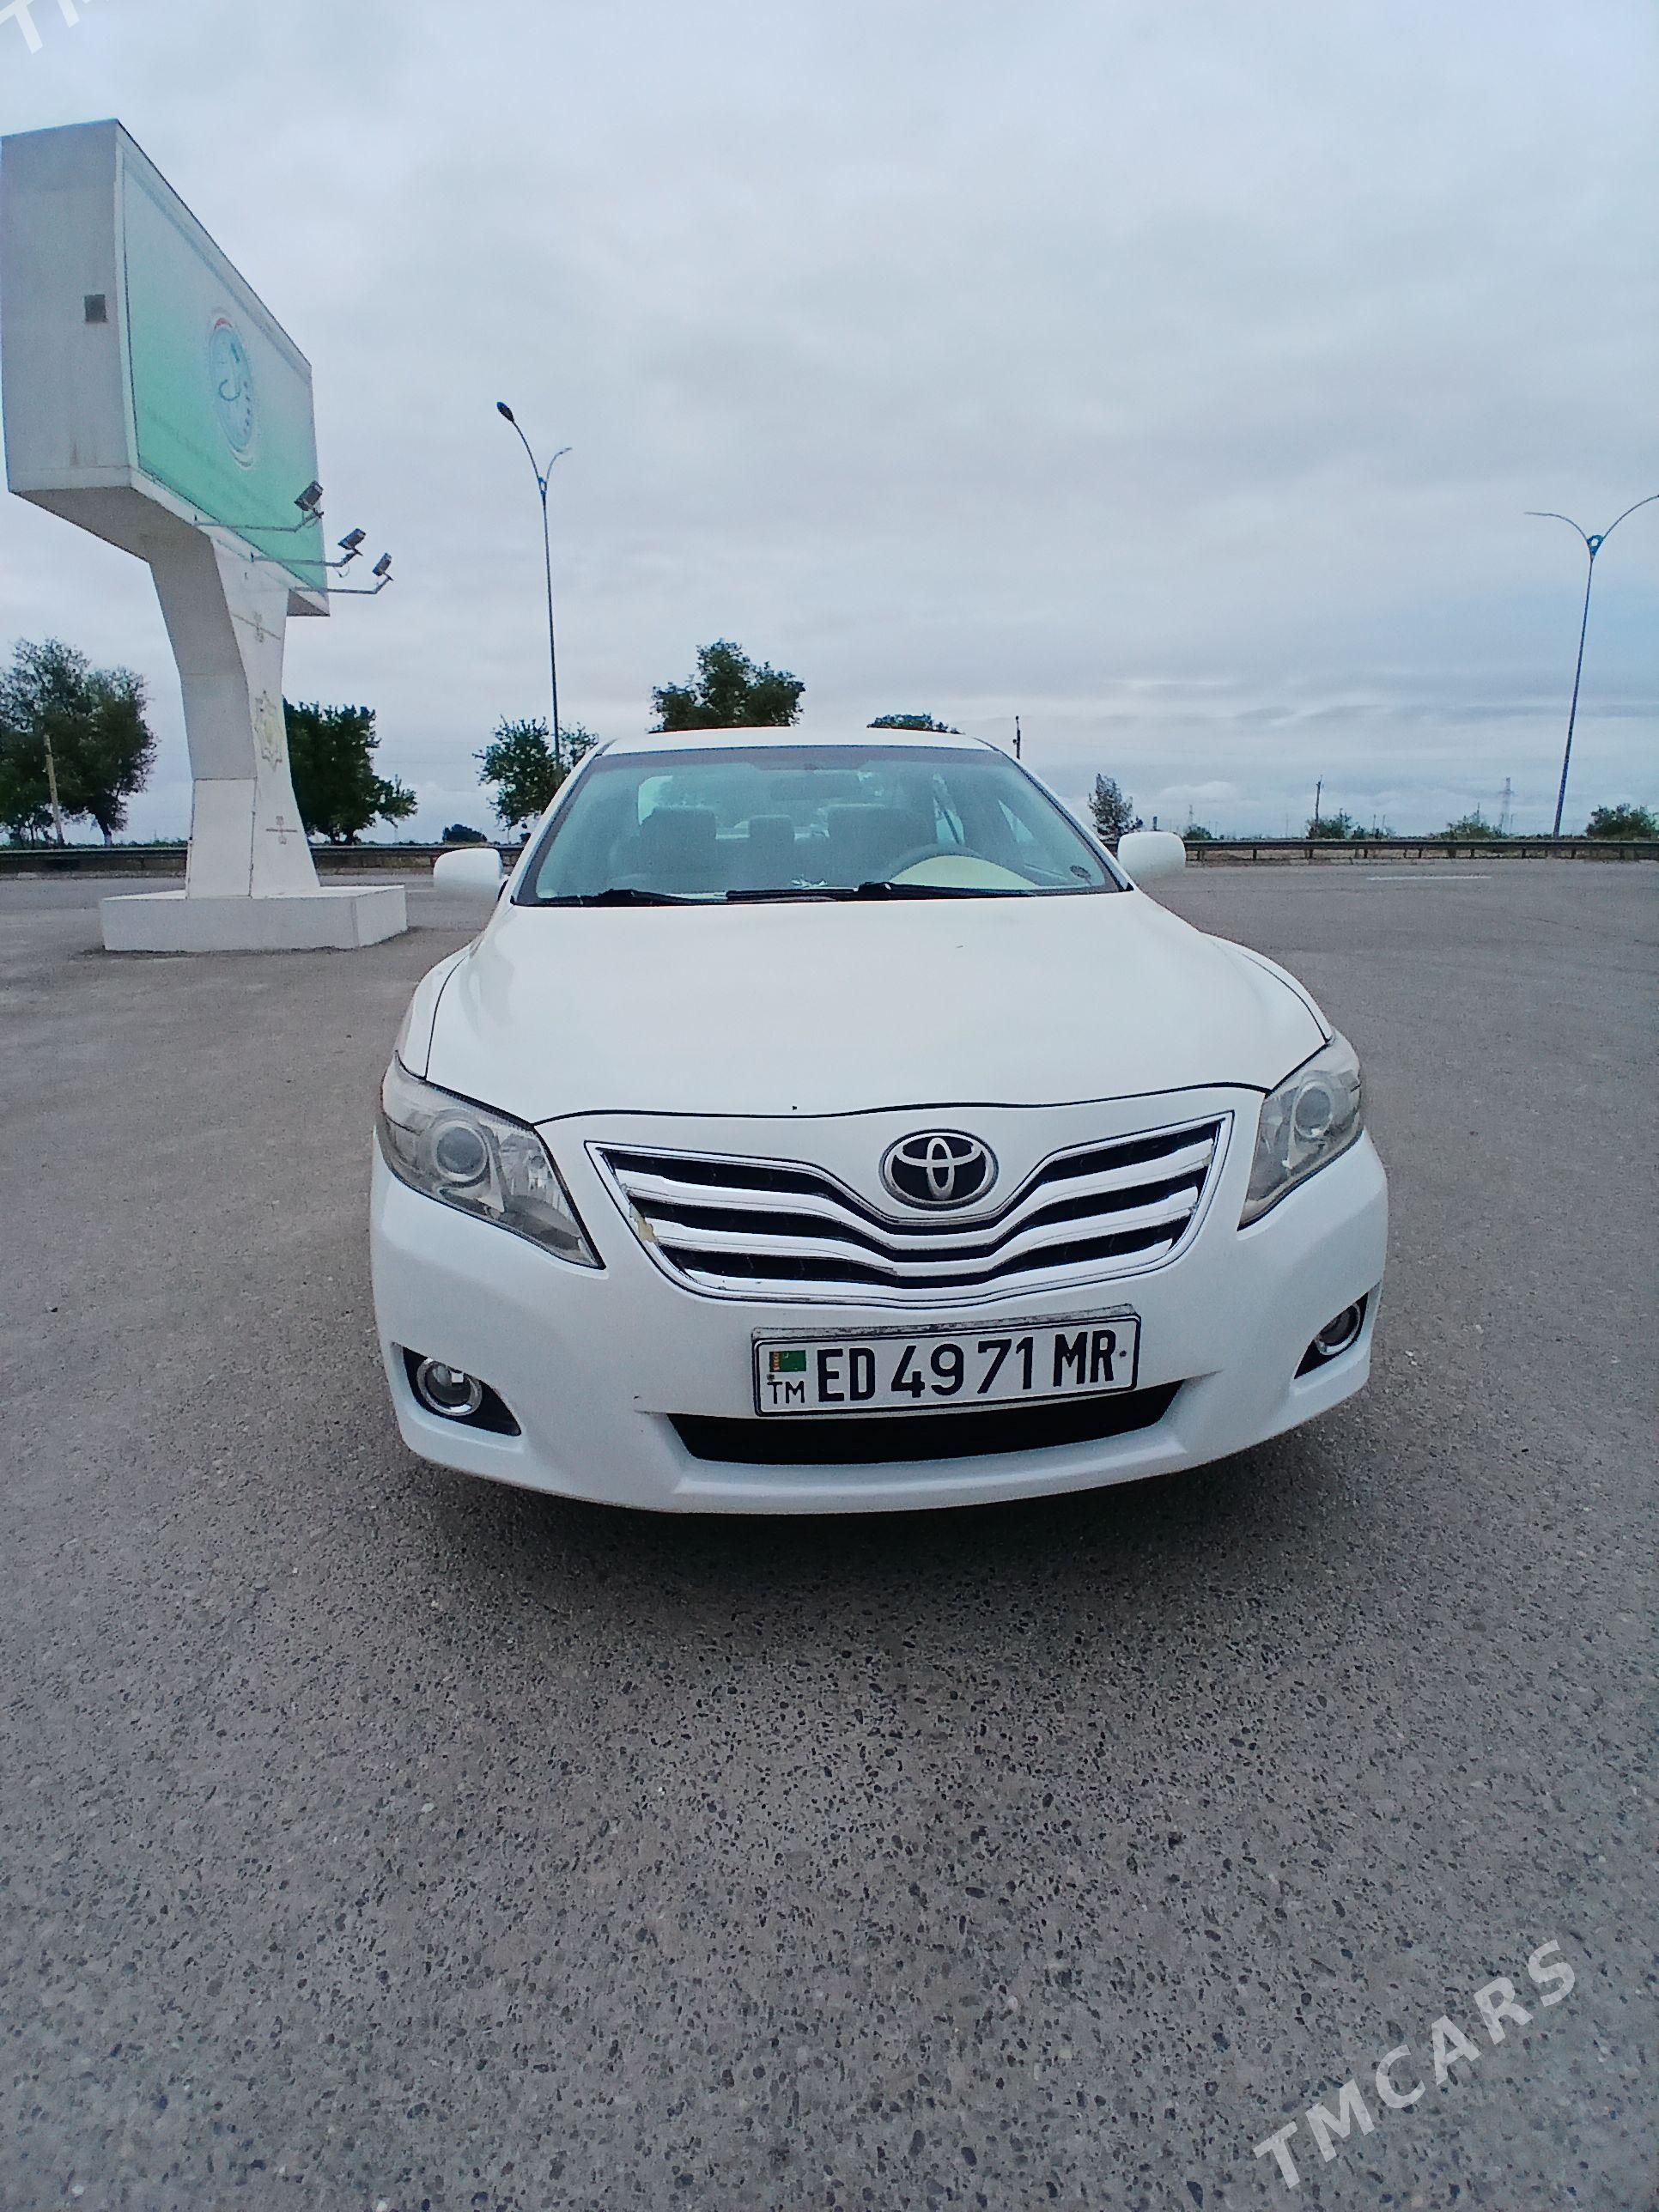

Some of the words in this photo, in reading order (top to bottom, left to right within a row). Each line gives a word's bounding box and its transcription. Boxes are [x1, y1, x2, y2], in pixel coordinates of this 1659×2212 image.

[817, 1347, 876, 1403] ED
[890, 1336, 1034, 1398] 4971
[1052, 1329, 1117, 1387] MR
[767, 1381, 805, 1405] TM
